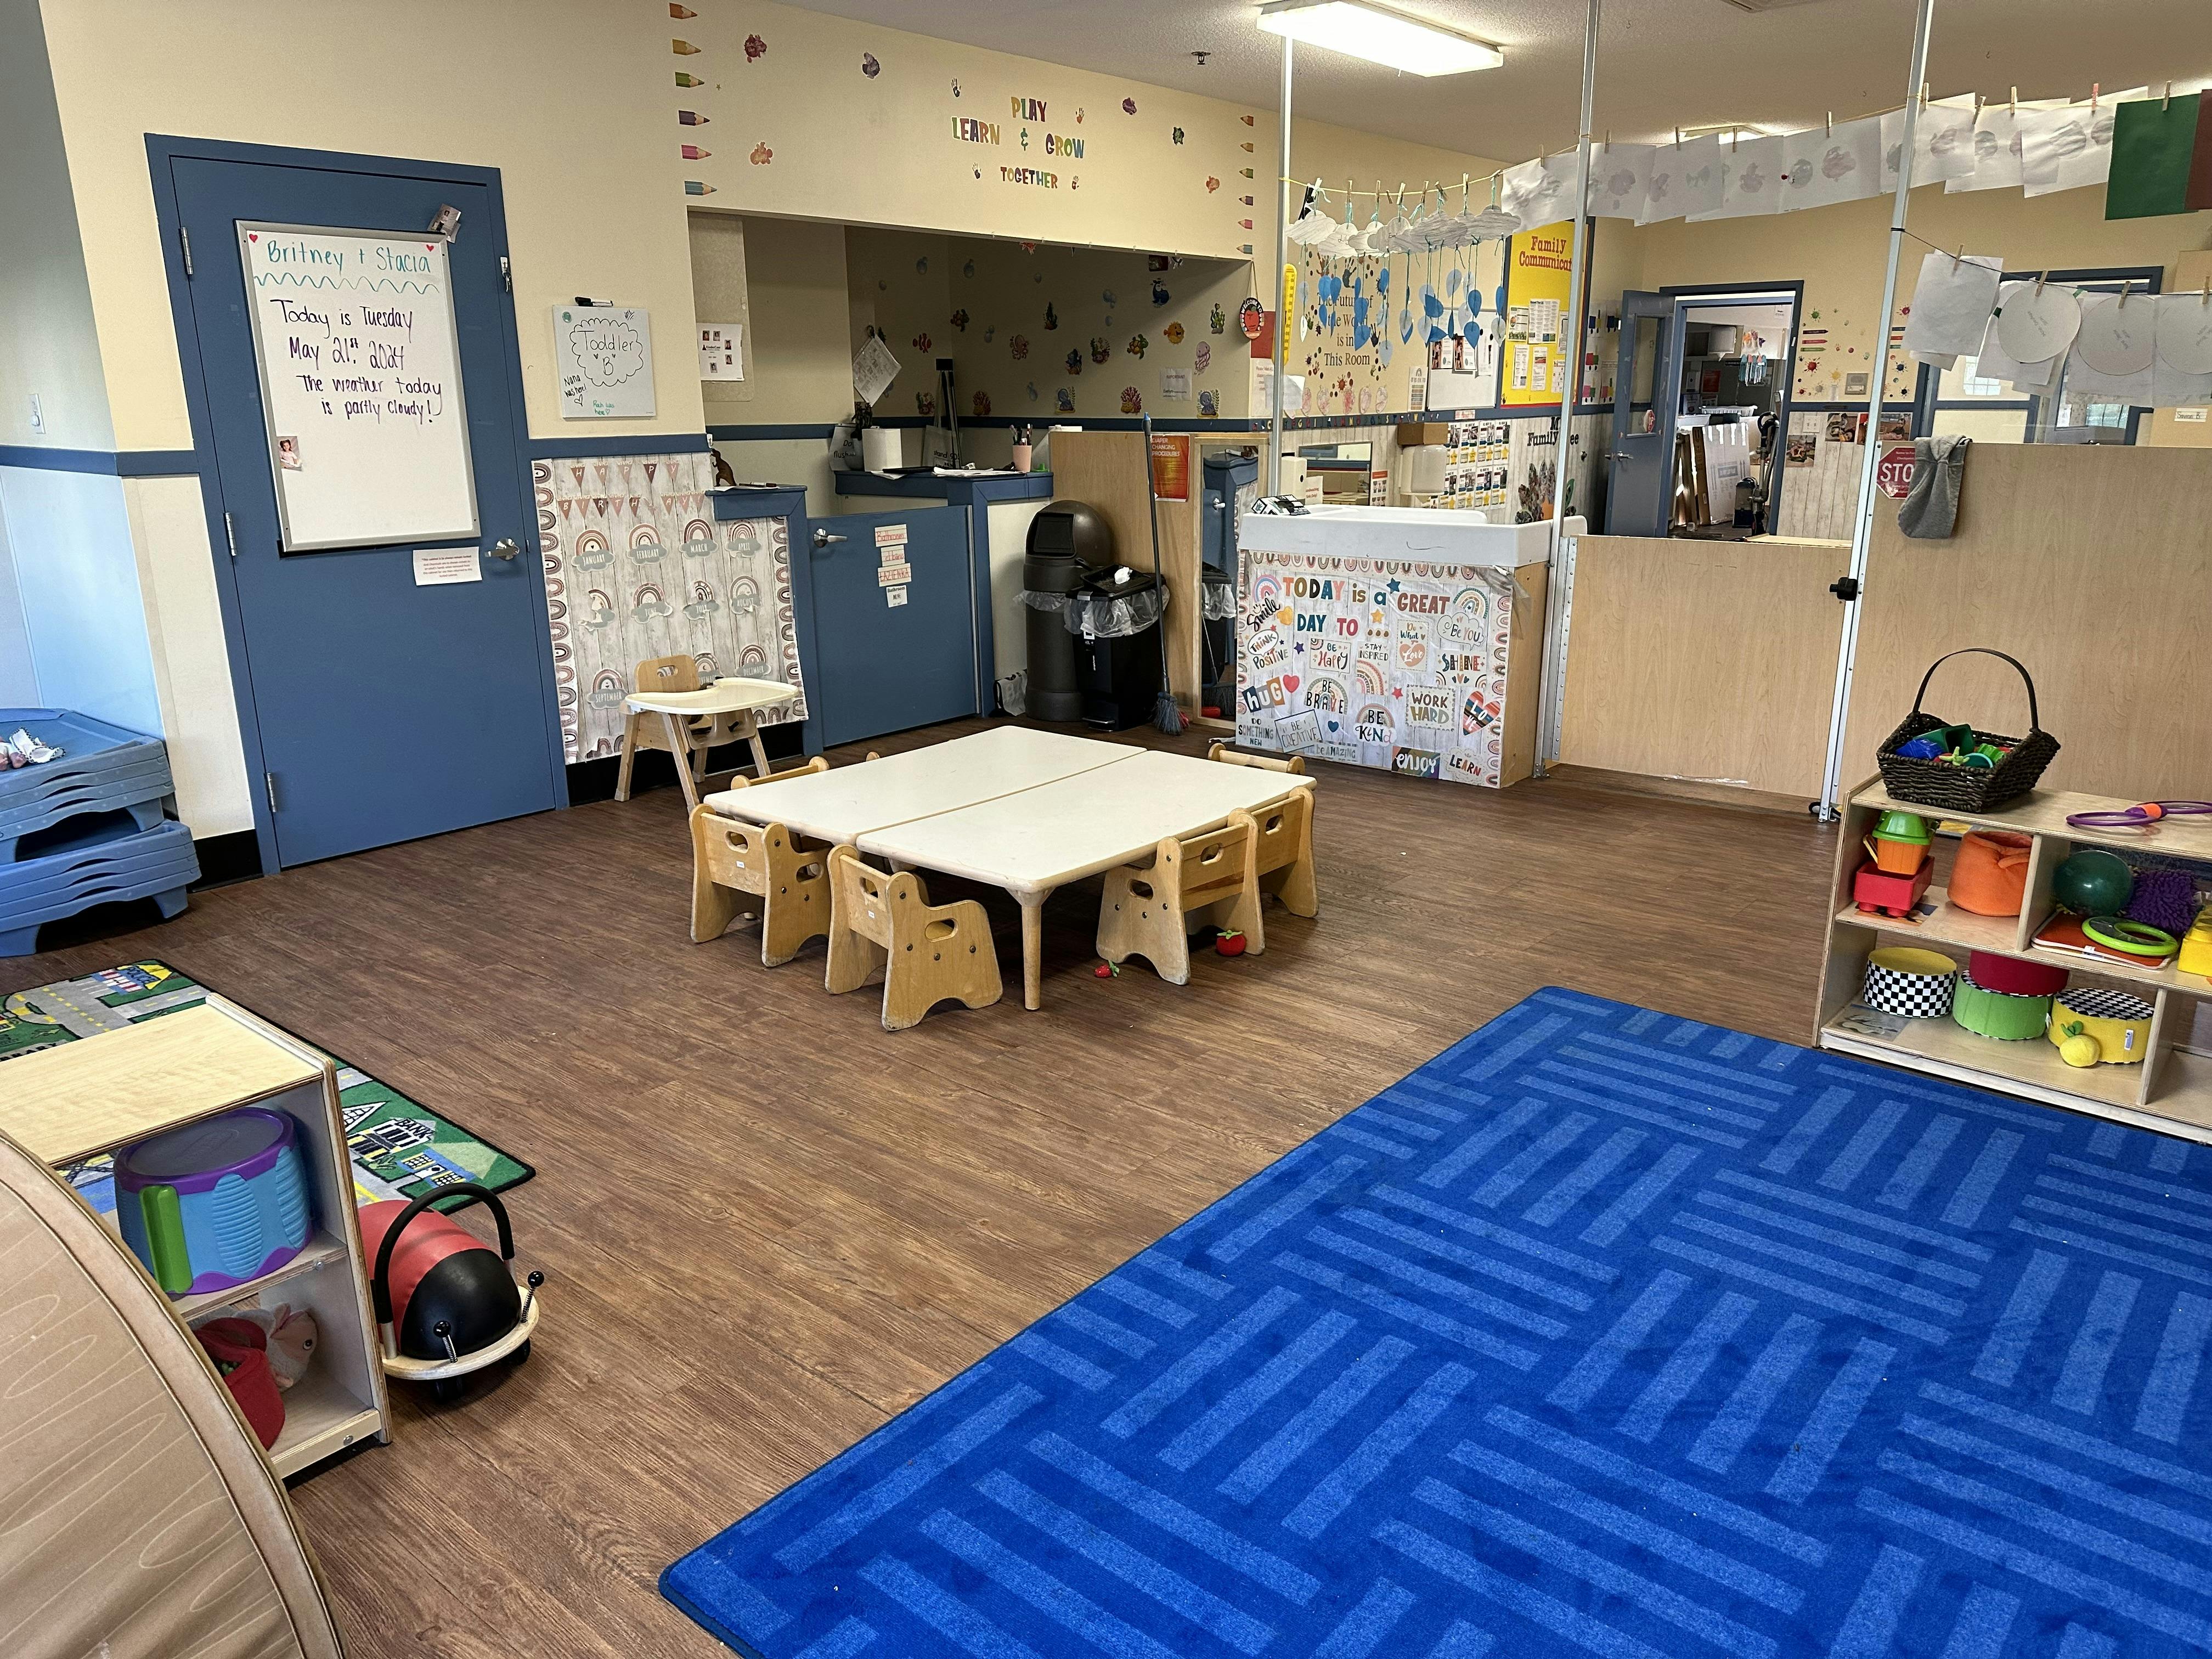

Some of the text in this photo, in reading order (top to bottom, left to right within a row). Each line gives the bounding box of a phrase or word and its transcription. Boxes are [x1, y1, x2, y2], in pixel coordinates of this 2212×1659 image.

[1011, 97, 1047, 122] PLAY
[951, 116, 1000, 145] LEARN
[1045, 133, 1085, 159] GROW
[1000, 166, 1058, 189] TOGETHER
[1531, 236, 1566, 254] Family
[268, 240, 343, 273] Britney
[376, 247, 431, 273] Stacia
[1519, 251, 1572, 272] Communicat
[270, 300, 413, 343] Today is Tuesday
[1328, 315, 1341, 327] te
[576, 330, 634, 352] Toddler
[1337, 334, 1354, 346] is in
[289, 336, 319, 370] May
[369, 340, 404, 370] 2024
[1324, 352, 1370, 366] This Room
[603, 357, 614, 376] B
[563, 374, 581, 387] Nana
[296, 375, 442, 415] The weather today
[321, 398, 332, 415] is
[344, 398, 380, 424] partly
[1527, 431, 1559, 447] Family
[576, 465, 676, 477] HAPPY
[1880, 463, 1914, 483] STO
[583, 543, 751, 566] JANUARY FEBRUARY MARCH APRIL
[737, 598, 754, 607] AUGUST
[1283, 577, 1450, 614] TODAY is a GREAT
[1246, 591, 1281, 632] Smile
[1297, 614, 1358, 636] DAY TO
[1407, 622, 1417, 631] Do
[1451, 624, 1481, 642] Be YOU
[1401, 630, 1419, 639] What
[1327, 643, 1337, 652] BE
[1358, 650, 1389, 661] INSPIRED
[1402, 648, 1424, 662] Love
[1442, 653, 1481, 672] SHINE
[596, 692, 622, 703] SEPTEMBER
[743, 665, 764, 676] DECEMBER
[1323, 679, 1332, 693] BE
[1306, 691, 1344, 714] BRAVE
[1411, 692, 1448, 709] WORK
[1368, 709, 1385, 725] BE
[1409, 706, 1449, 724] HARD
[1238, 724, 1274, 740] SOMETHING
[1290, 720, 1302, 731] BE
[1250, 738, 1262, 746] NEW
[1281, 727, 1318, 748] CREATIVE
[1325, 746, 1356, 758] AMAZING
[1449, 754, 1481, 776] LEARN
[127, 966, 157, 984] POLICE
[394, 1119, 432, 1138] BANK
